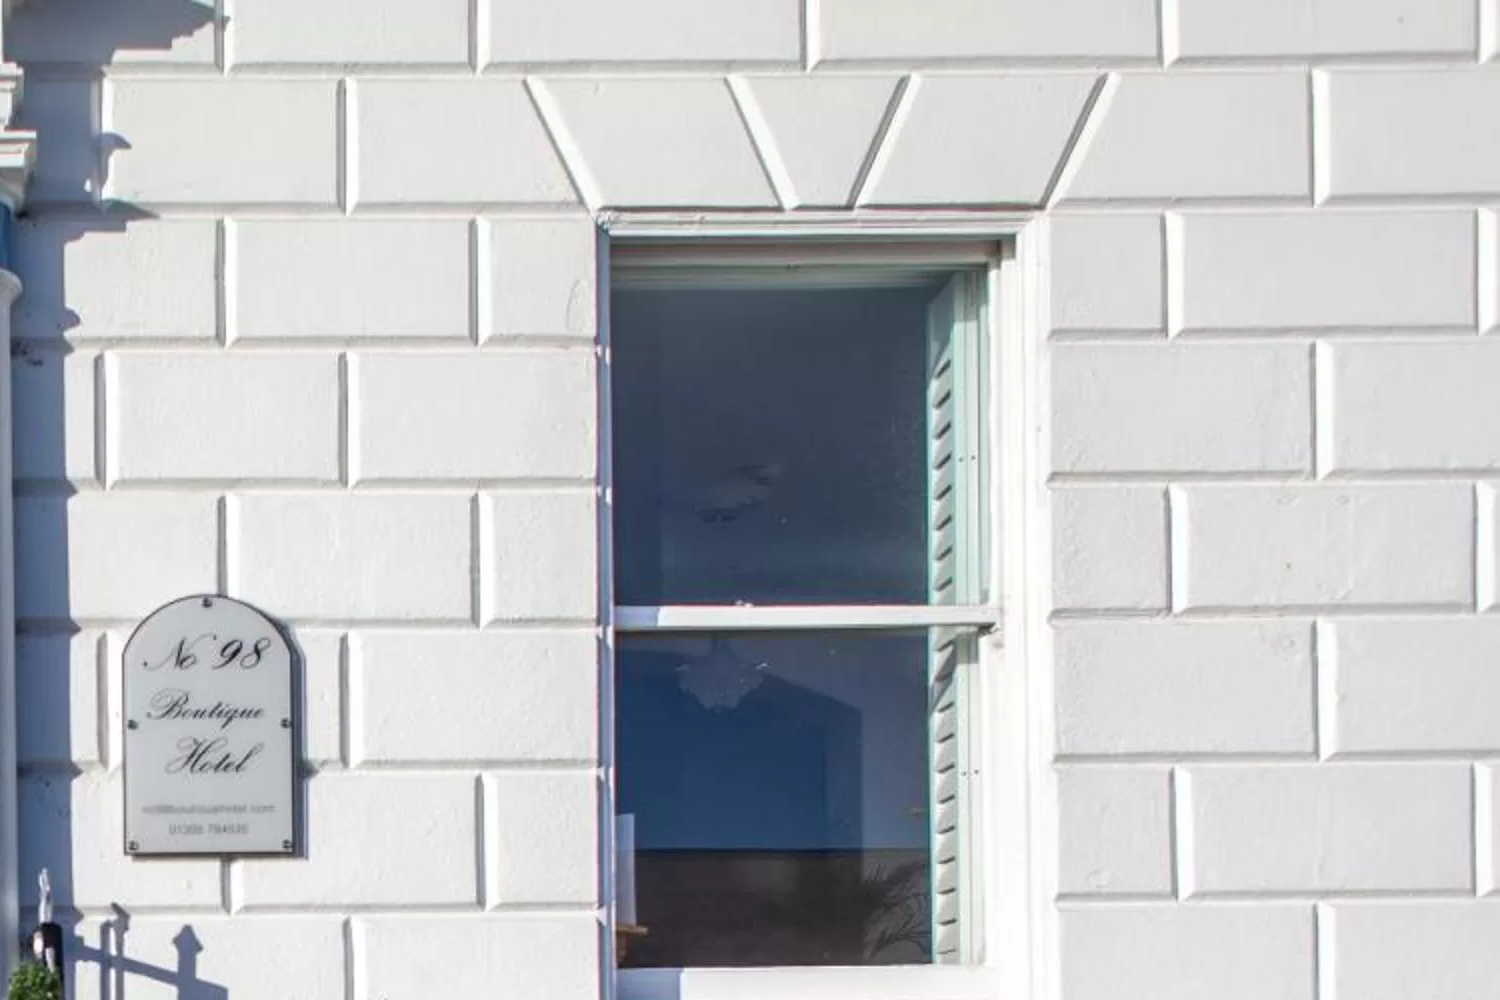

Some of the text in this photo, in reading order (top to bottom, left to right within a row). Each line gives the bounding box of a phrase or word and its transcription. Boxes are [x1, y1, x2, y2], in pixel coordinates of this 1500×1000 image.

[211, 638, 271, 669] 98
[147, 688, 264, 731] Boutique
[164, 736, 265, 774] Hotel
